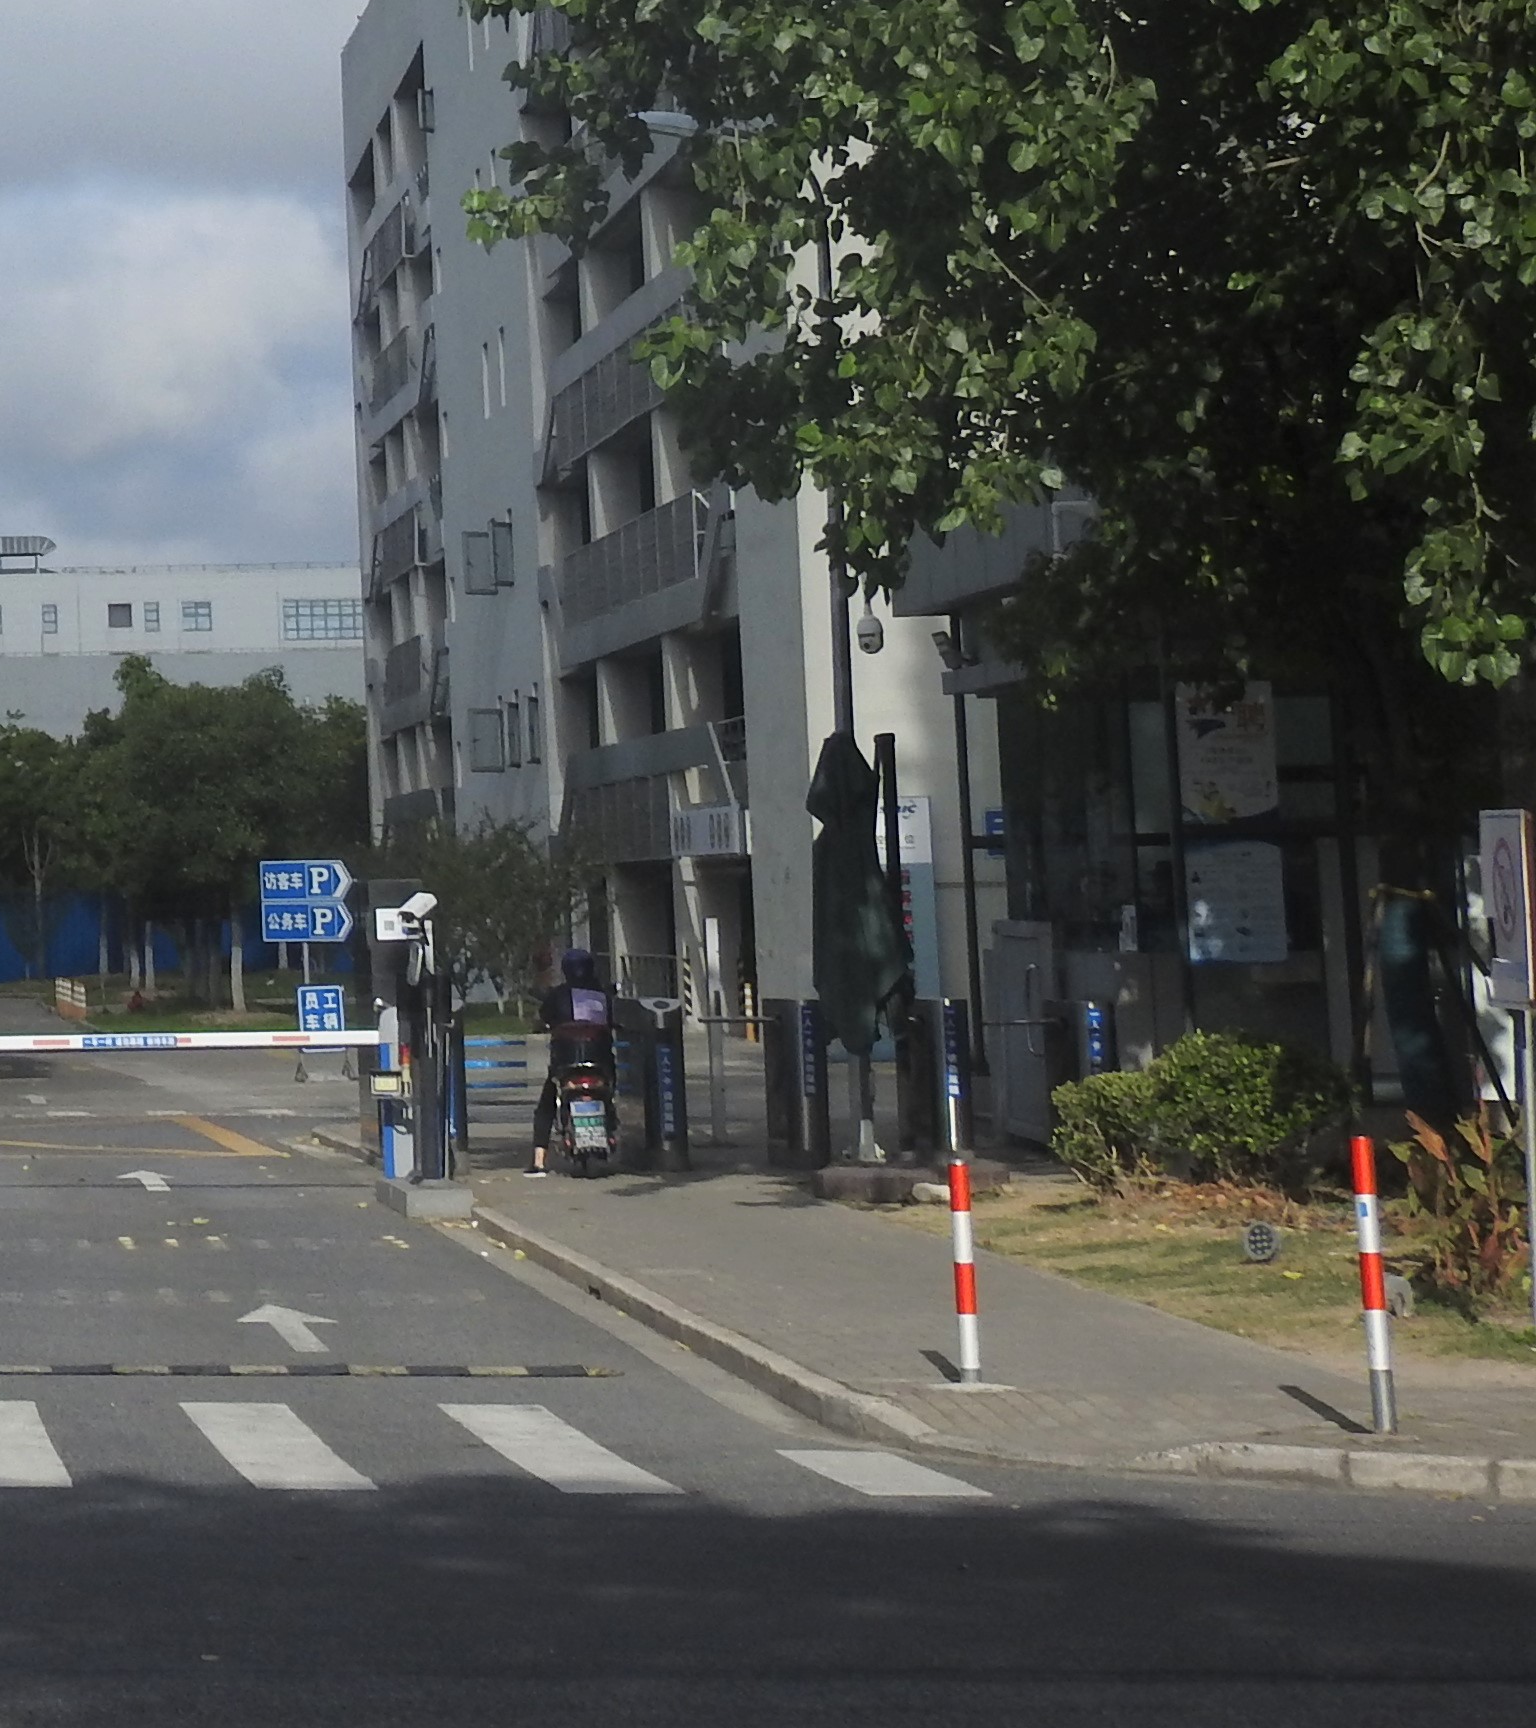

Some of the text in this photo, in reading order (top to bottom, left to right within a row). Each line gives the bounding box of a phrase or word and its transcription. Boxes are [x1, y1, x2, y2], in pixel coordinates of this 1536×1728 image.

[264, 867, 330, 894] 访客车 P
[267, 908, 333, 935] 公务车 P
[305, 992, 338, 1010] 员工
